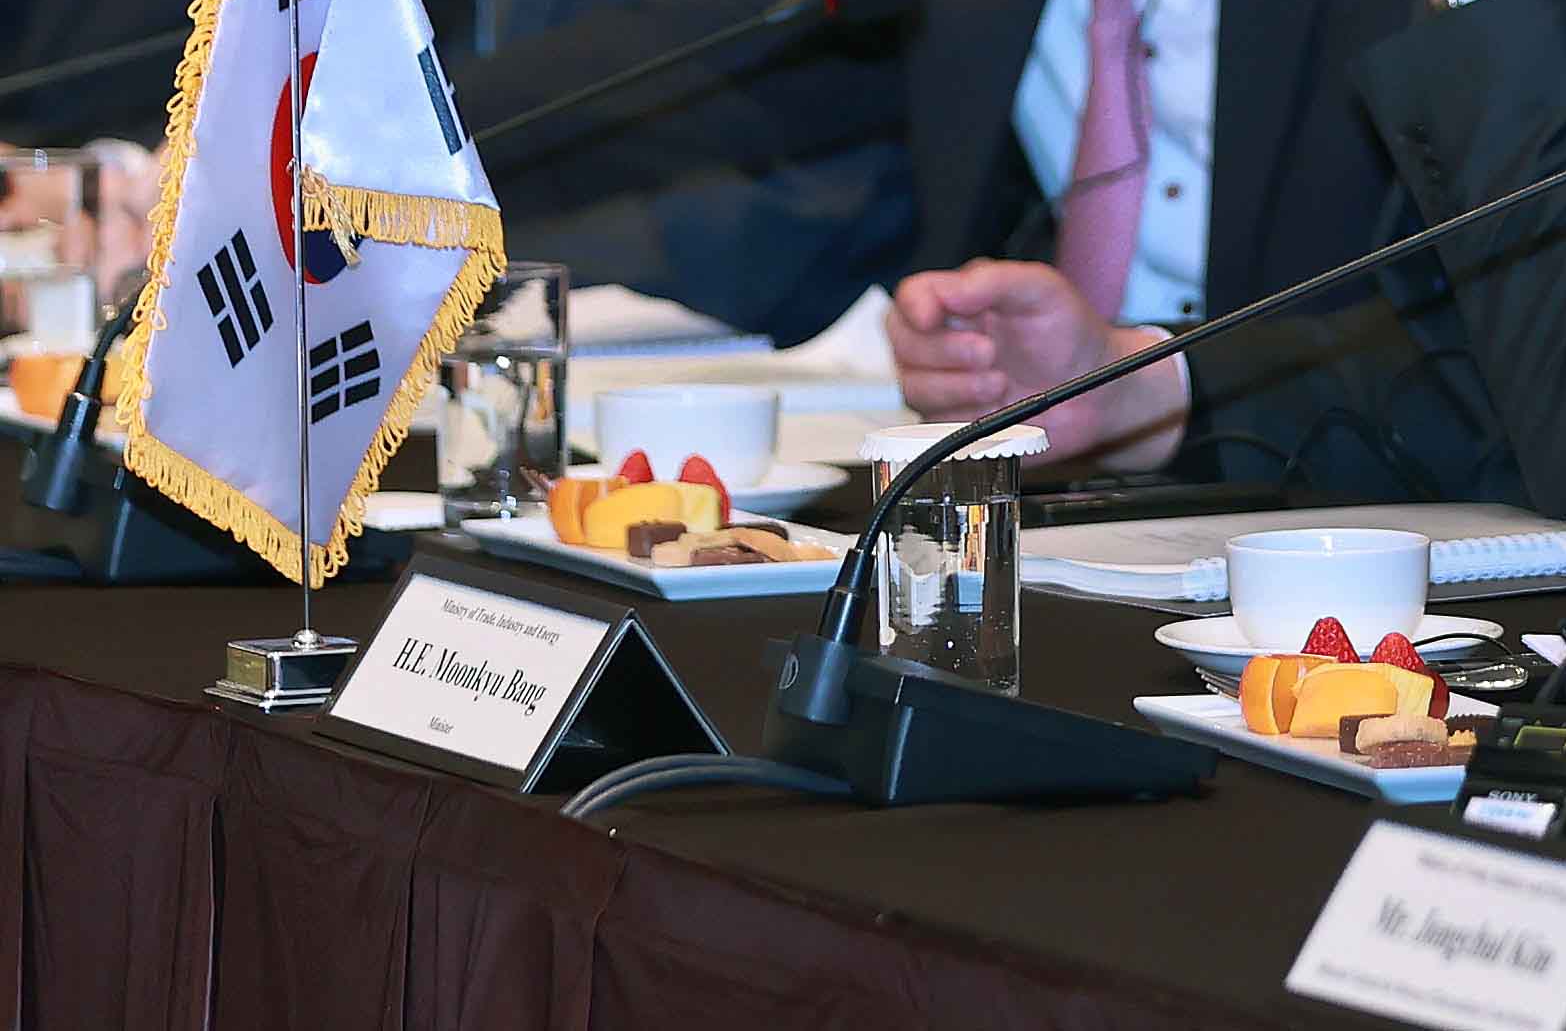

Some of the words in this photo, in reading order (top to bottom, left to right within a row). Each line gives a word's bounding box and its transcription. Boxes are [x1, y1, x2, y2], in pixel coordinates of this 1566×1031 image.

[443, 598, 467, 620] Ministry
[496, 613, 524, 634] Industry
[523, 623, 540, 637] and
[536, 625, 560, 646] Energy
[393, 637, 434, 676] H.E.
[429, 647, 505, 702] Moonkyu
[501, 668, 547, 716] Bang
[430, 716, 454, 734] Minister
[1487, 789, 1538, 804] SONY
